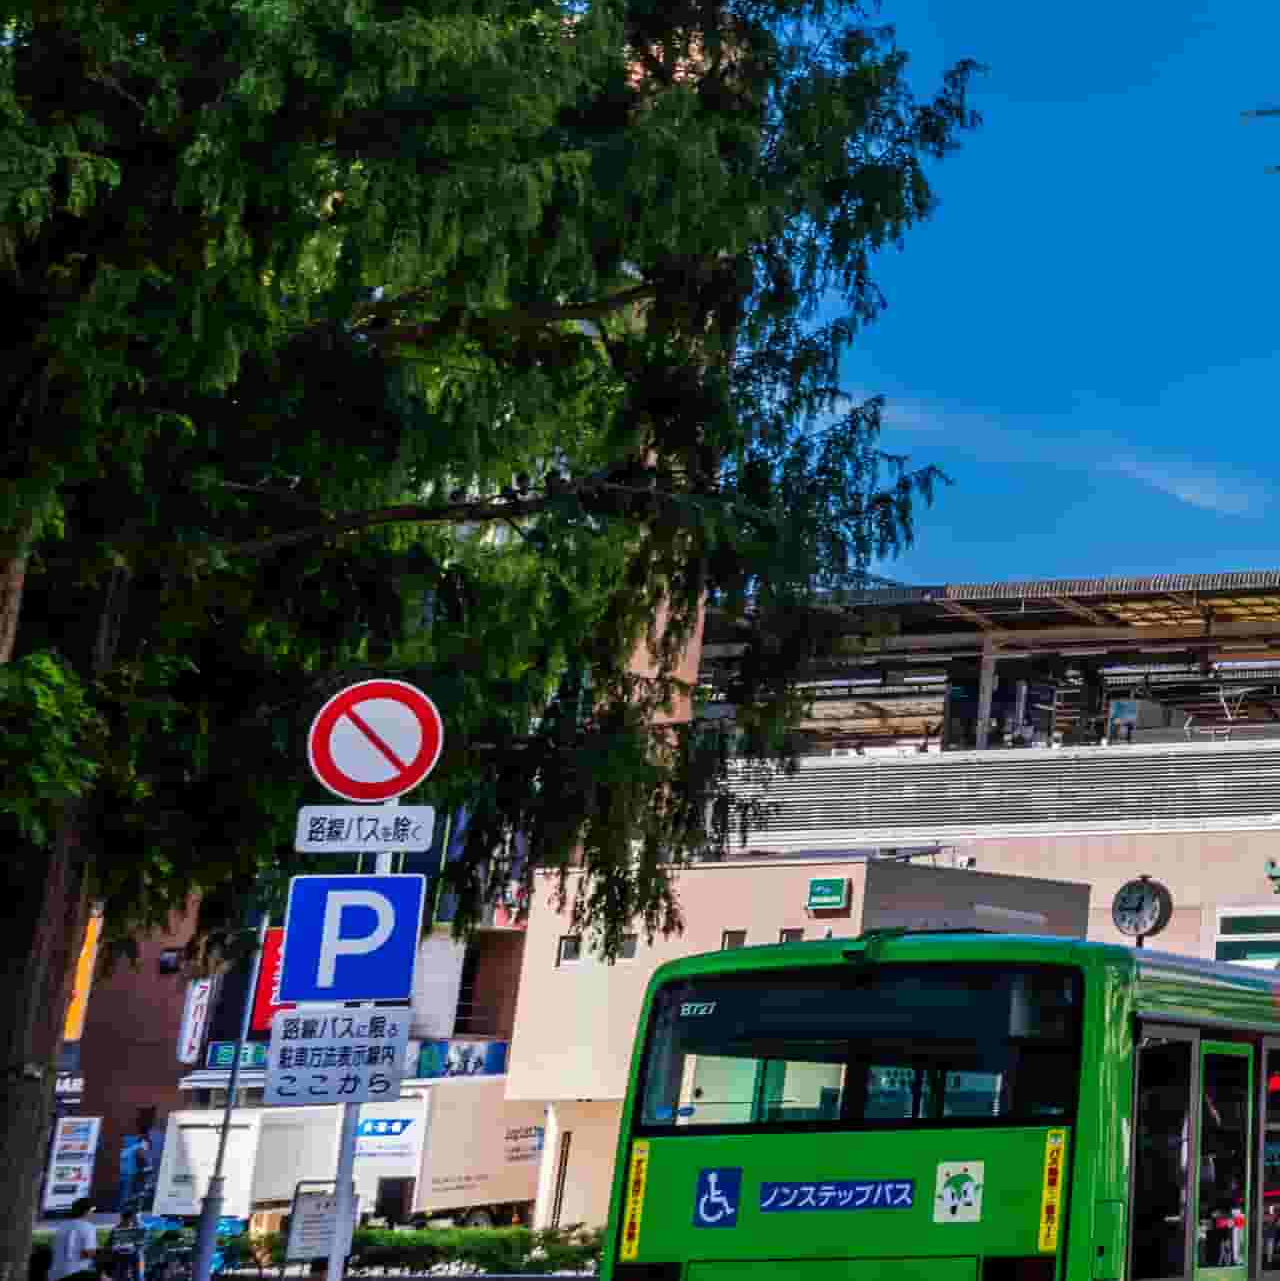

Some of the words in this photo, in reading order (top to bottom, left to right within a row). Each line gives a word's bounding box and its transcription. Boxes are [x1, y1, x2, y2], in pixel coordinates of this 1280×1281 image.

[307, 815, 425, 842] 路線バスを除く
[316, 889, 395, 988] P
[276, 1073, 391, 1097] ここから
[760, 1183, 913, 1207] ノンステップバス
